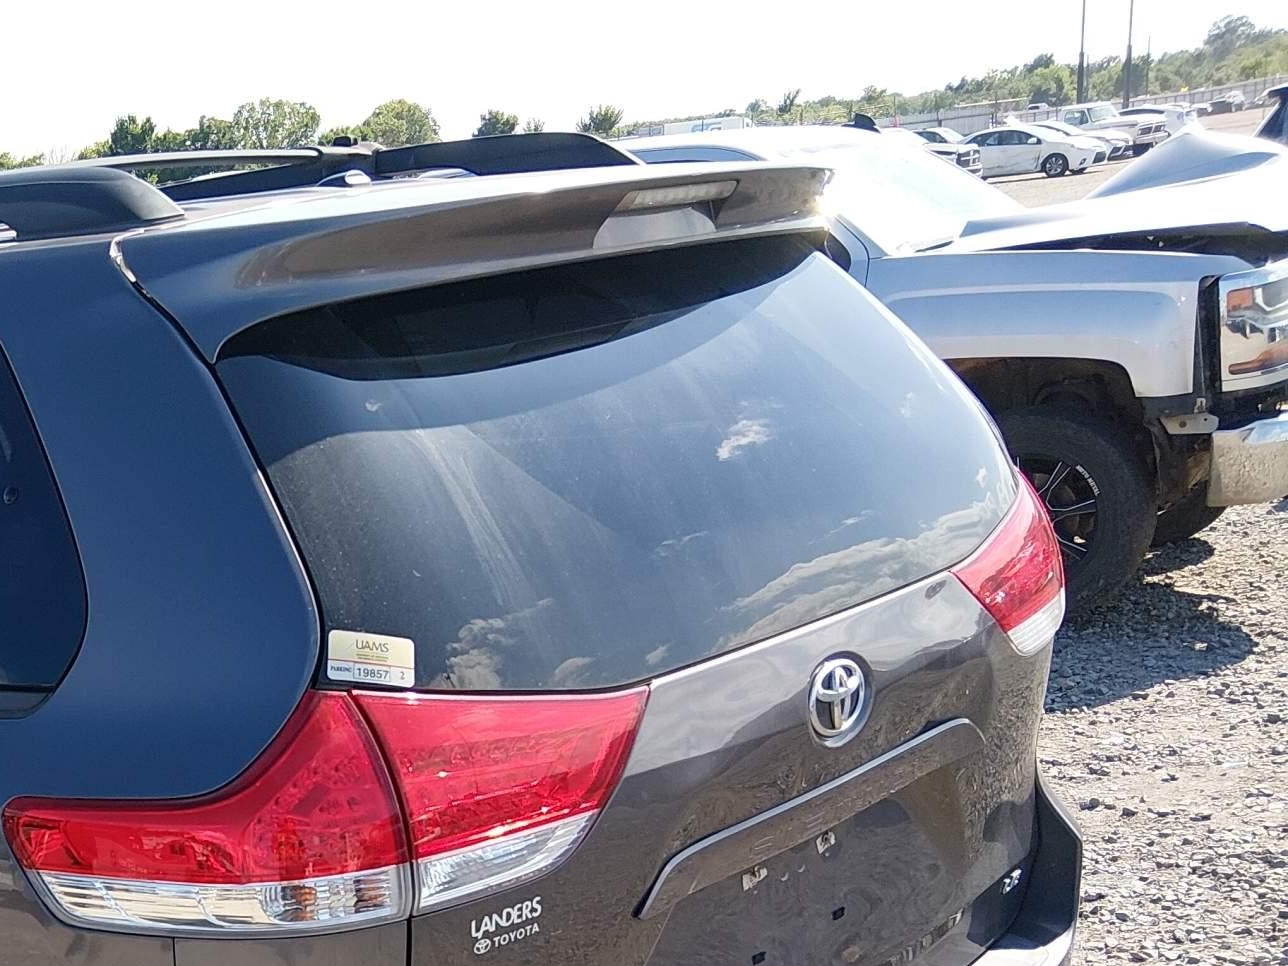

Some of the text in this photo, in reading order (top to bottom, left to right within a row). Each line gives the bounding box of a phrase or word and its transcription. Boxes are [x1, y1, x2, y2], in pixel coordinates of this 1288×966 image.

[355, 639, 389, 653] UAMS
[356, 667, 390, 680] 19857
[399, 671, 406, 680] 2
[470, 896, 542, 939] LANDERS
[493, 922, 540, 948] TOYOTA
